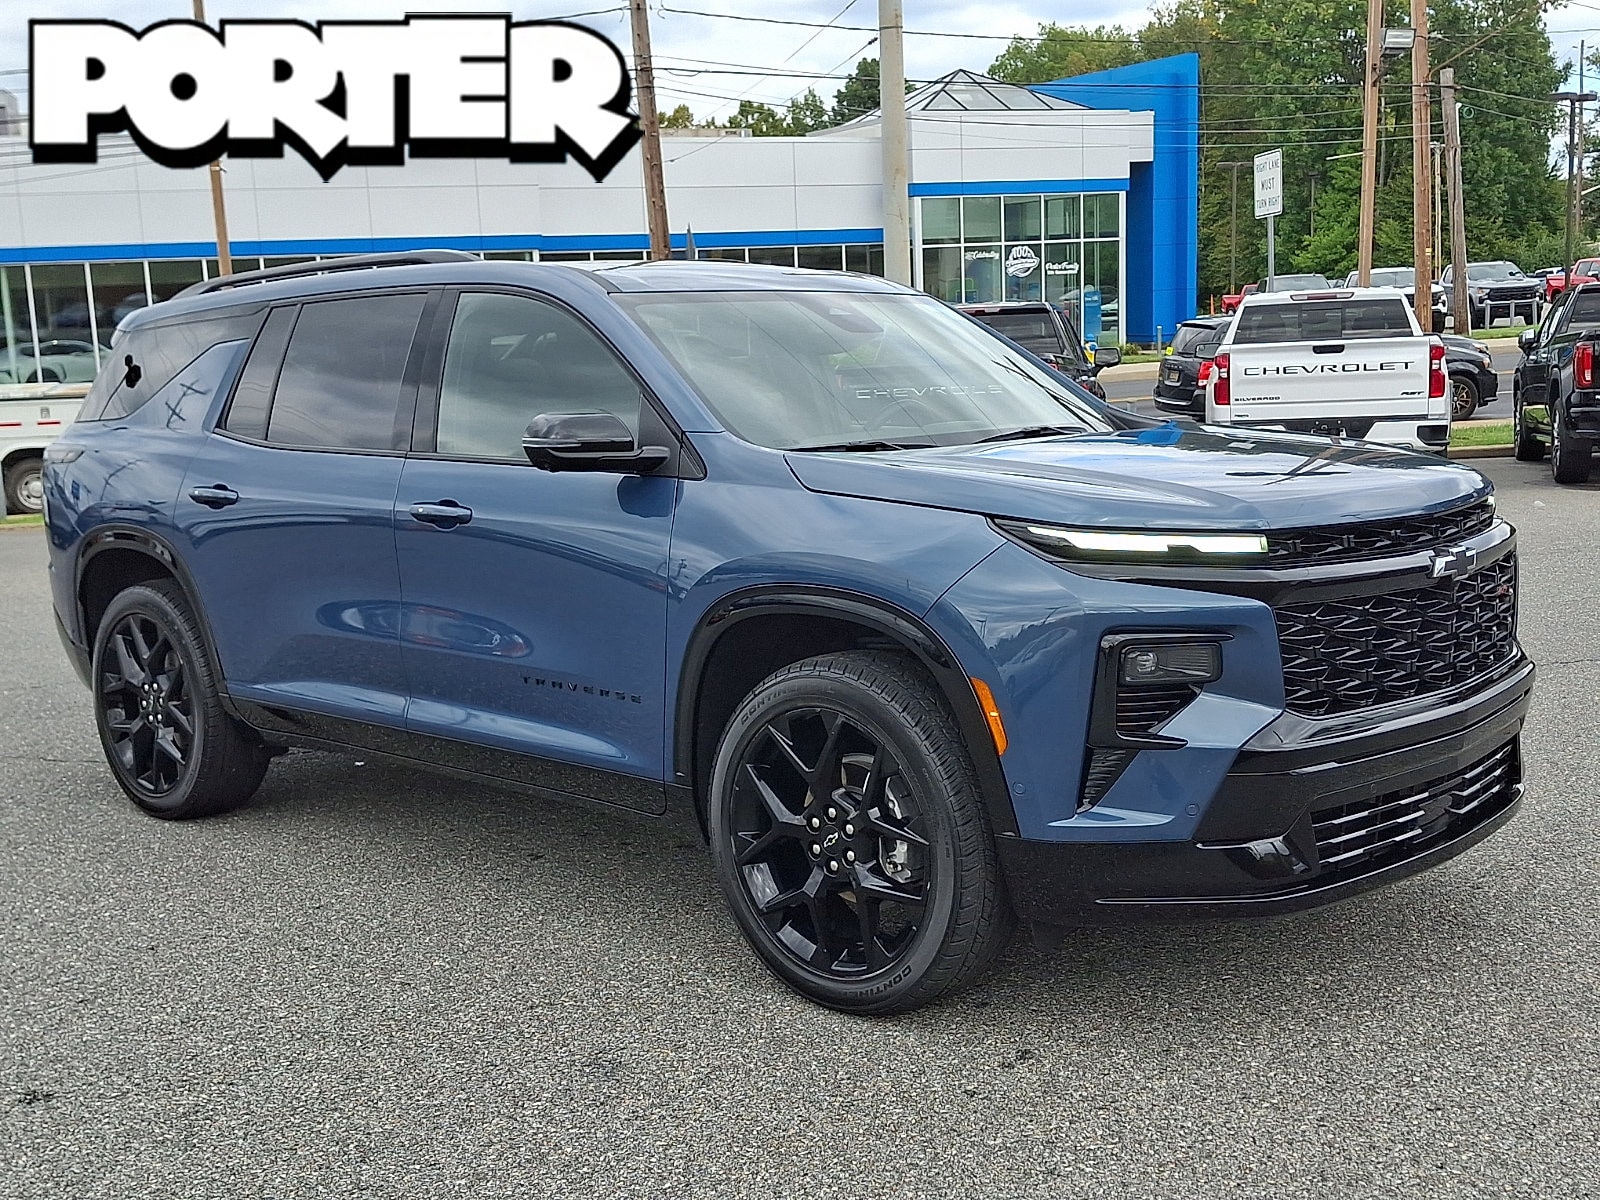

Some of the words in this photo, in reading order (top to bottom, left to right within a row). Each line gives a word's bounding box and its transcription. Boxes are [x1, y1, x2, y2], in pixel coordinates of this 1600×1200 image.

[1256, 161, 1268, 173] RIGHT
[1268, 158, 1280, 170] LANE
[1260, 176, 1275, 191] MUST
[1256, 198, 1267, 210] TURN
[1244, 361, 1415, 376] CHEVROLET
[523, 676, 642, 704] TRAVERSE
